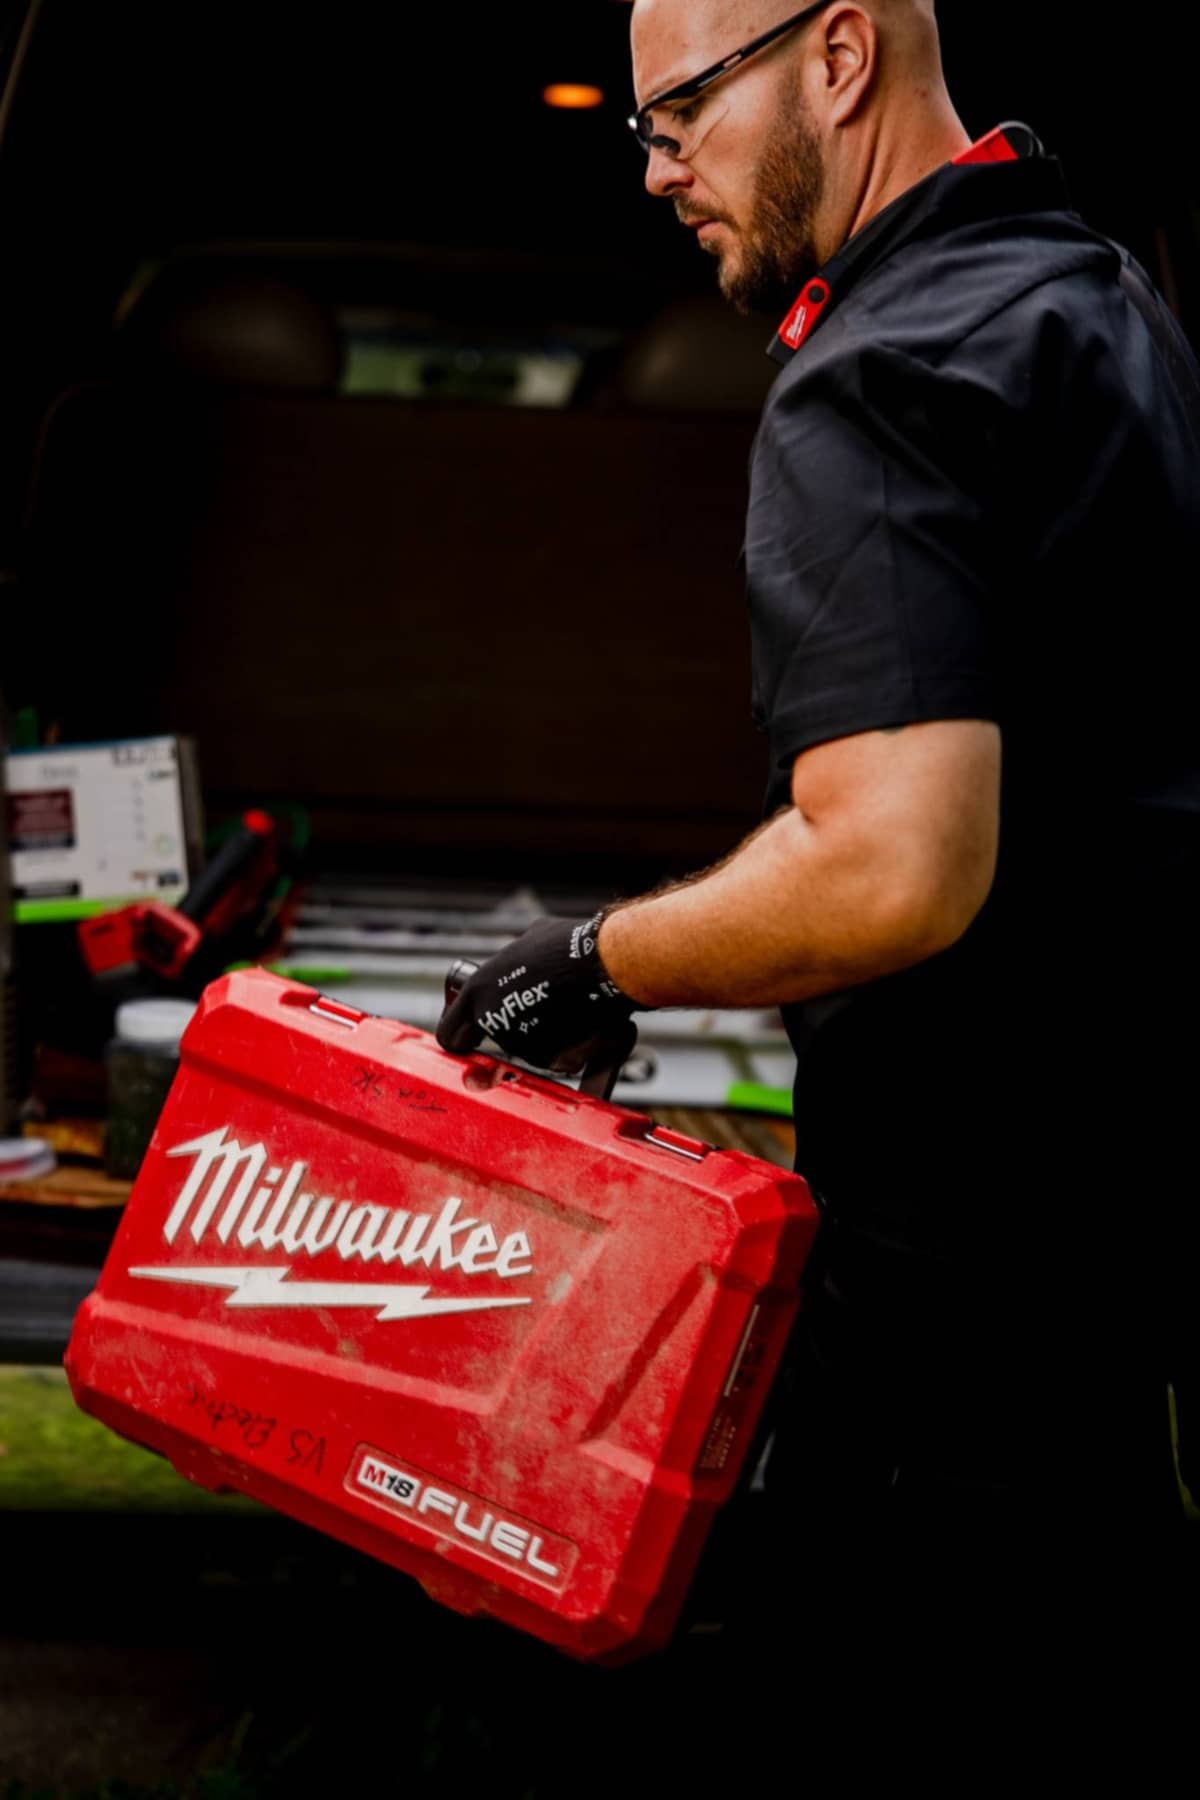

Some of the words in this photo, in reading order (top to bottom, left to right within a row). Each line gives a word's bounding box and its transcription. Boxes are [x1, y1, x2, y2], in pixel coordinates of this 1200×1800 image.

[163, 1125, 533, 1279] Milwaukee
[285, 1427, 327, 1475] VS
[363, 1464, 415, 1498] M18
[417, 1486, 559, 1577] FUEL
